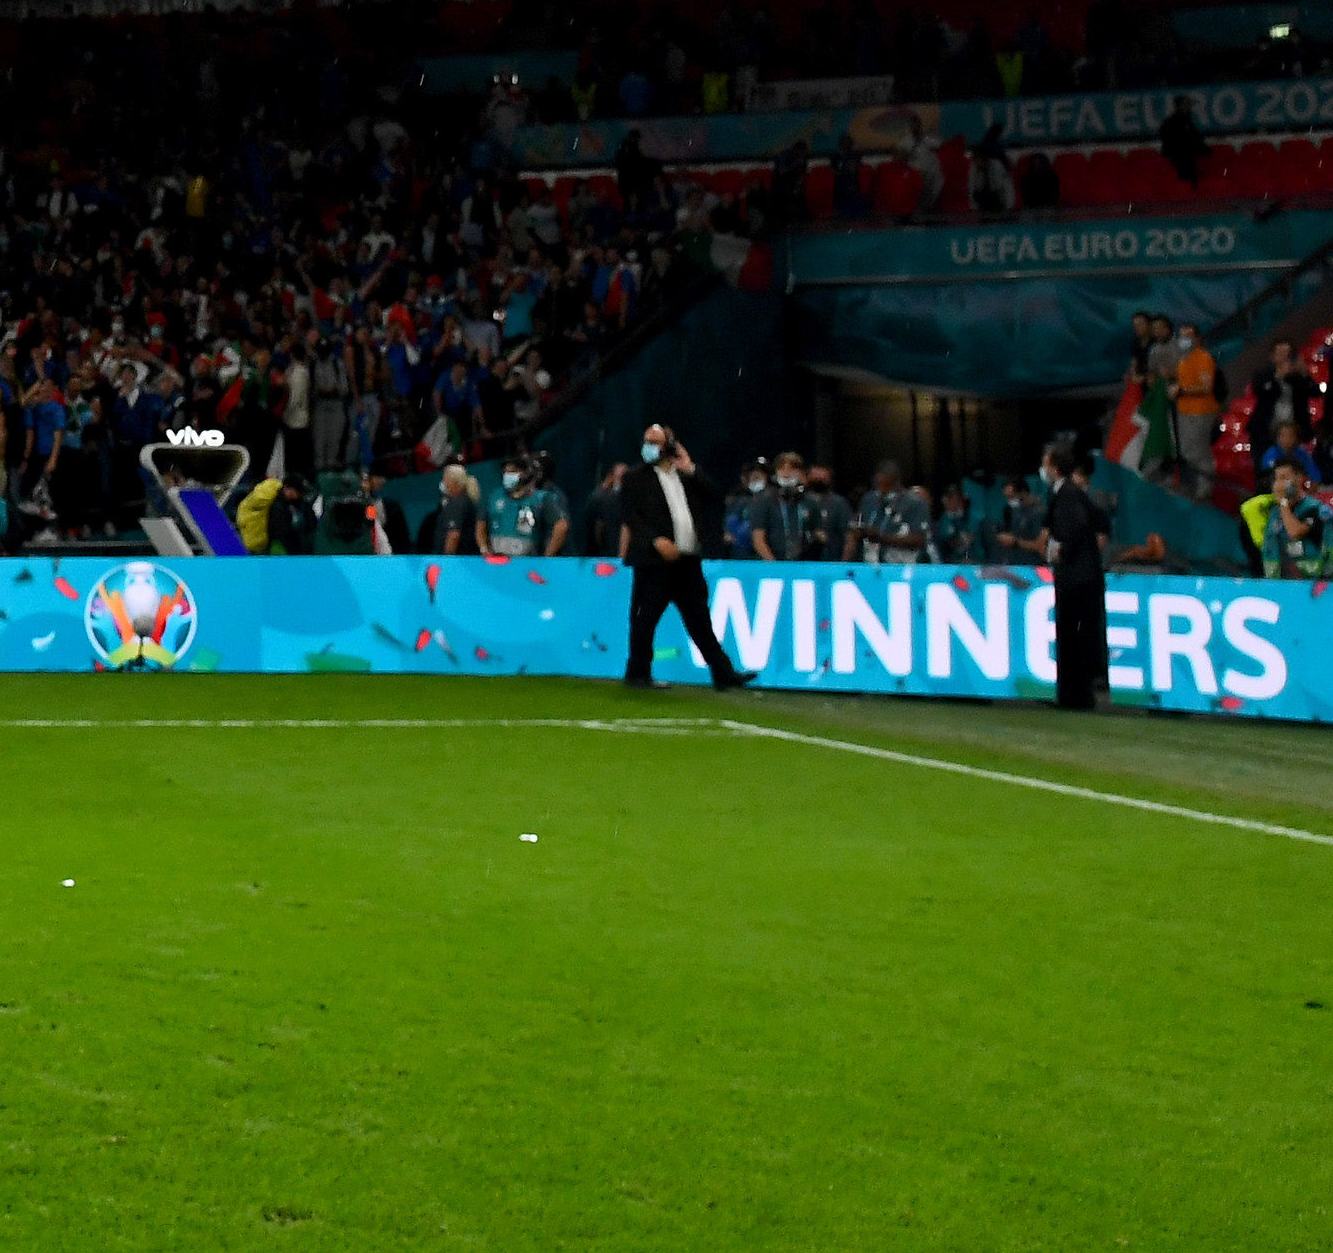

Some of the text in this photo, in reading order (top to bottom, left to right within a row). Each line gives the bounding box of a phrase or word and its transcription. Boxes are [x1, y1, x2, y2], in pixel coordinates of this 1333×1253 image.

[950, 226, 1234, 265] UEFA EURO 2020
[165, 425, 225, 447] vivo
